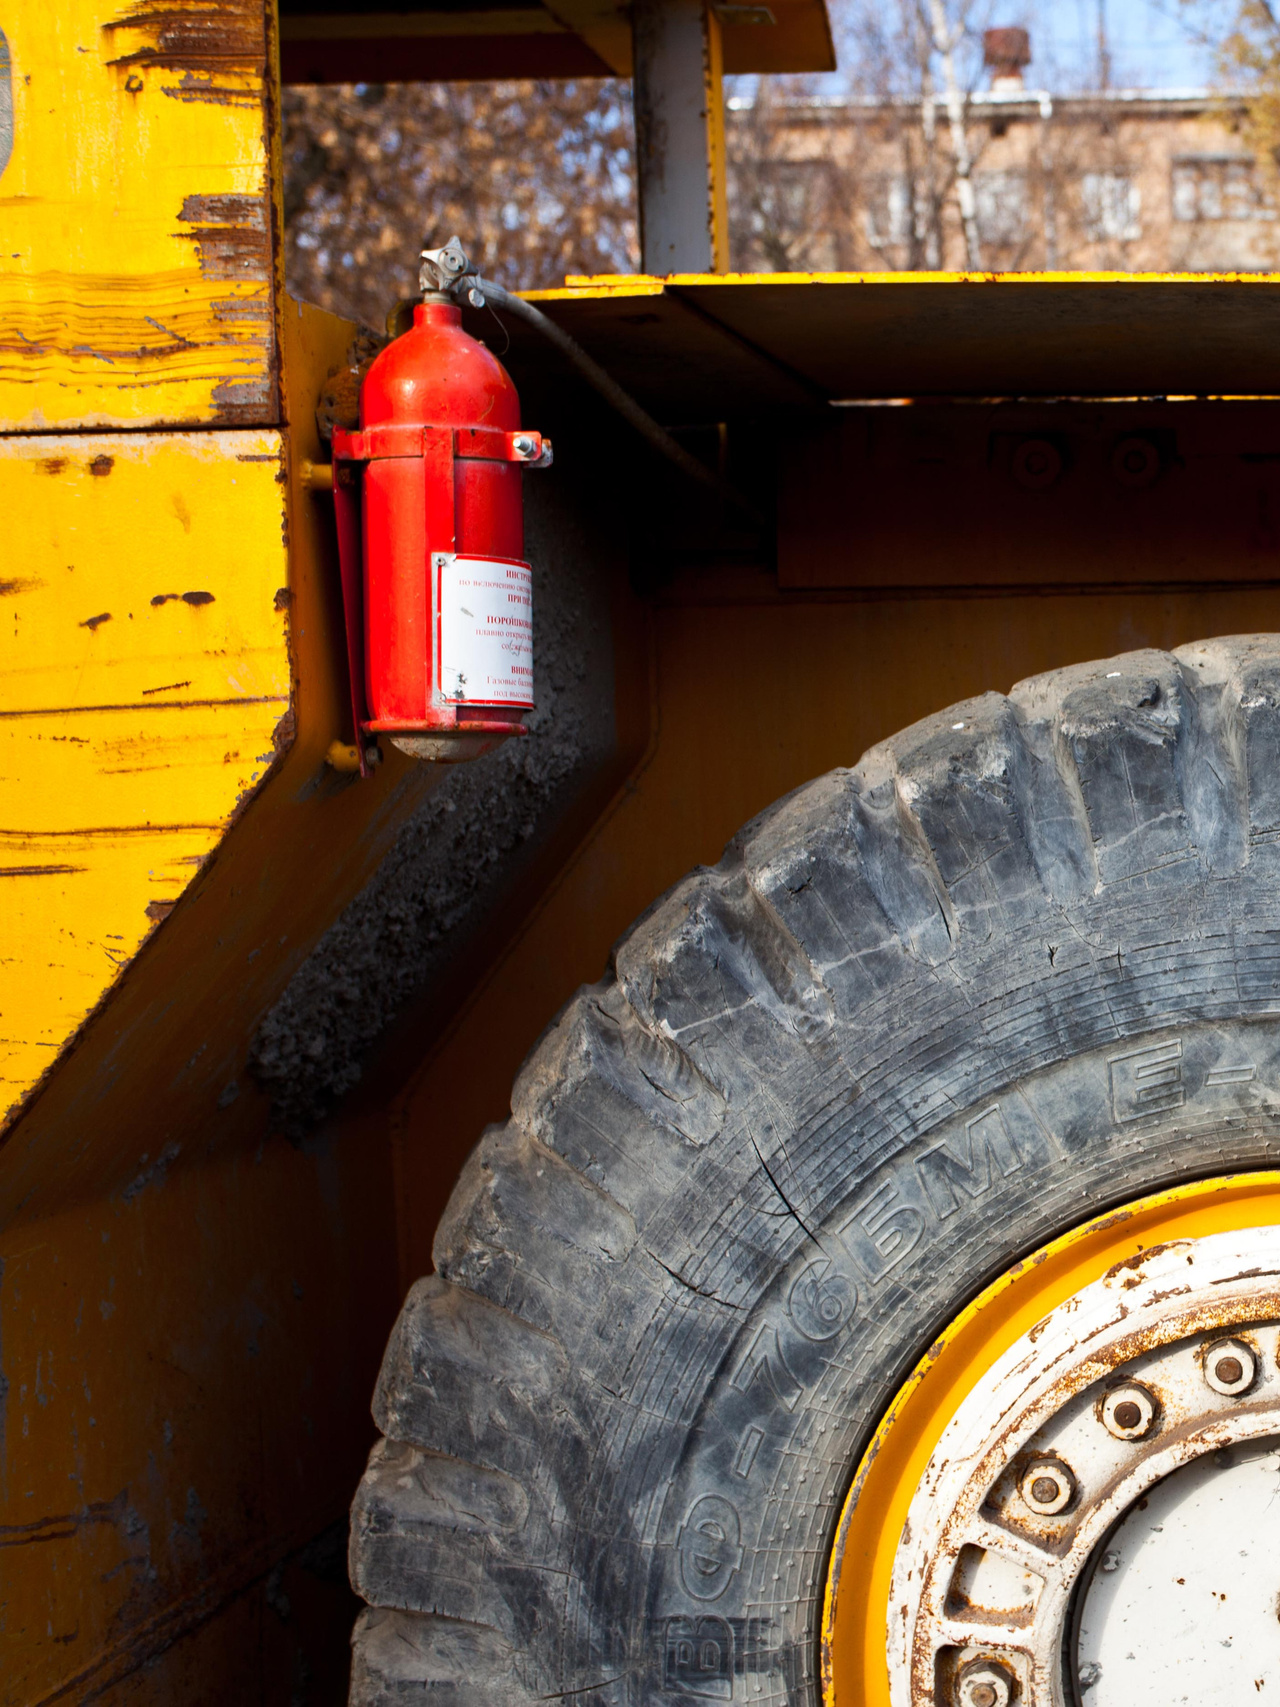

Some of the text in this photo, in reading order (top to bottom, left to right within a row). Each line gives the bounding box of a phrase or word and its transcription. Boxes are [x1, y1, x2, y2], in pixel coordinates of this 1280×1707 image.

[459, 579, 471, 587] по
[473, 580, 516, 590] включению
[508, 594, 521, 604] ПРИ
[475, 628, 505, 638] плавно
[487, 675, 517, 686] Газовые
[493, 690, 508, 699] под
